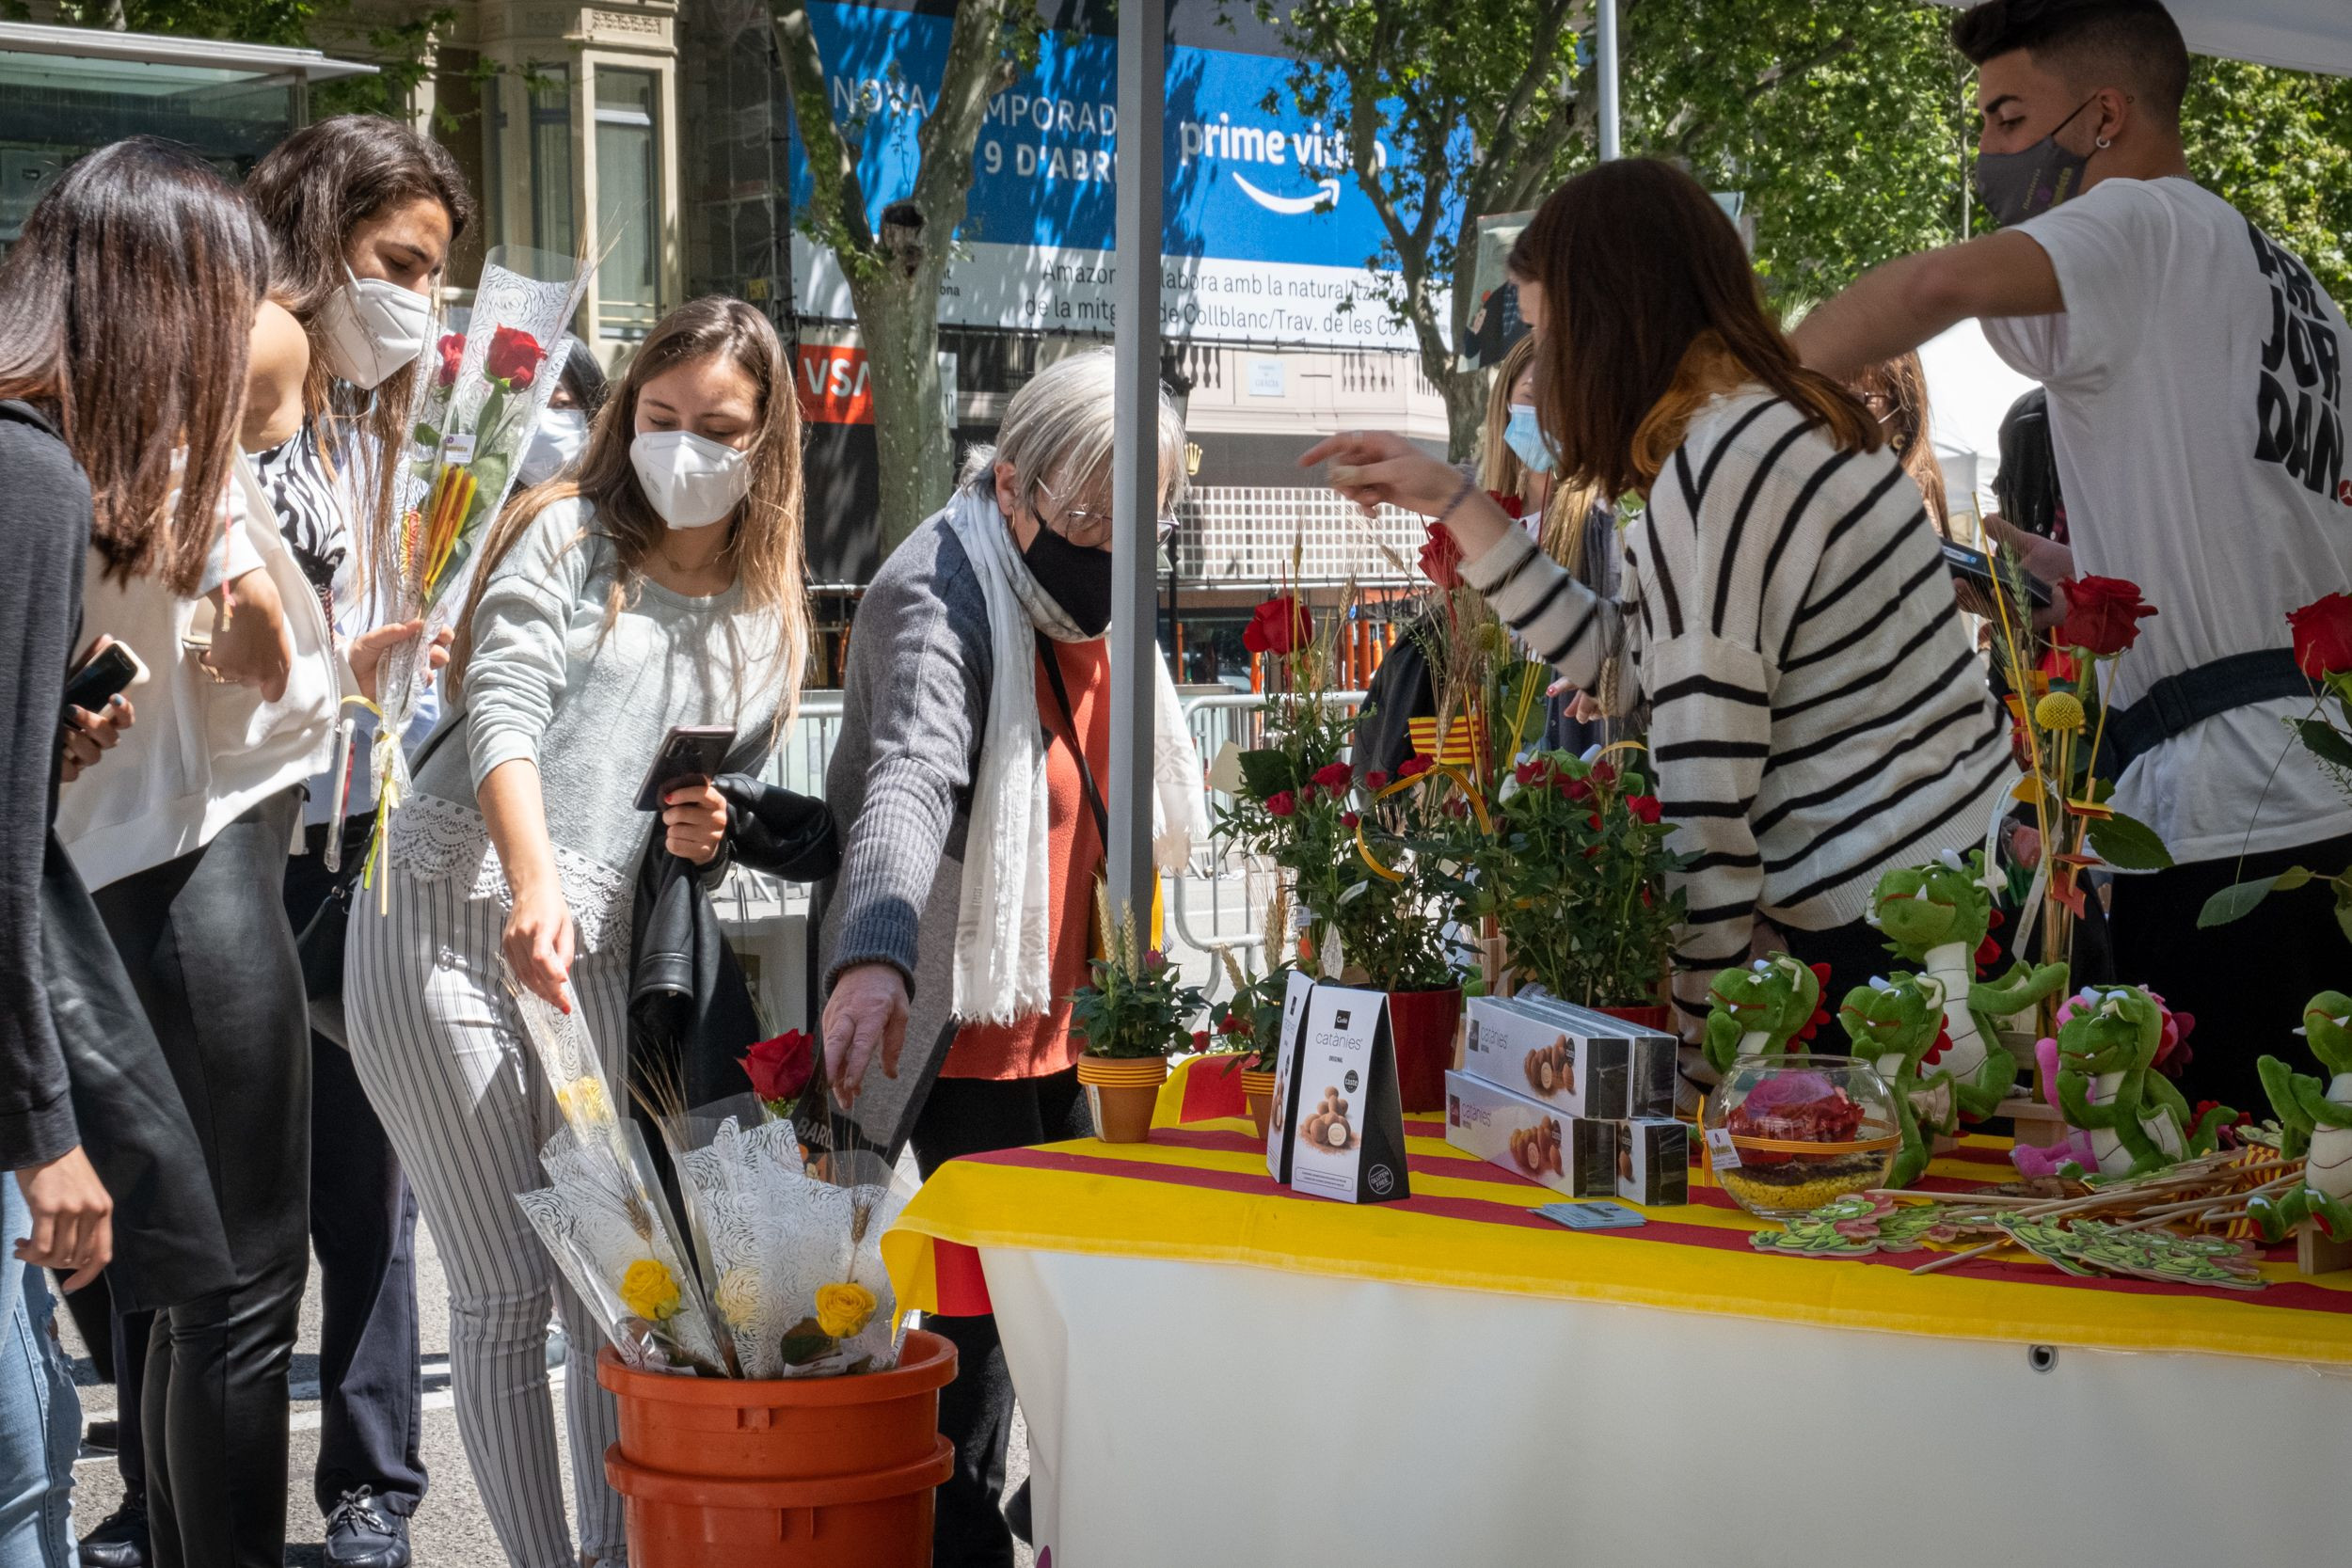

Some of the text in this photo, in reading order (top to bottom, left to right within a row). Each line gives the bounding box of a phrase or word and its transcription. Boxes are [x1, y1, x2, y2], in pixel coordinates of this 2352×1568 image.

[1180, 112, 1285, 166] prime
[1224, 273, 1262, 295] amb
[1267, 274, 1282, 296] la
[1025, 293, 1048, 317] de
[1055, 294, 1071, 318] la
[1323, 311, 1343, 333] de
[1349, 311, 1372, 334] les
[2261, 283, 2341, 412] JOR
[2254, 370, 2344, 504] DAN
